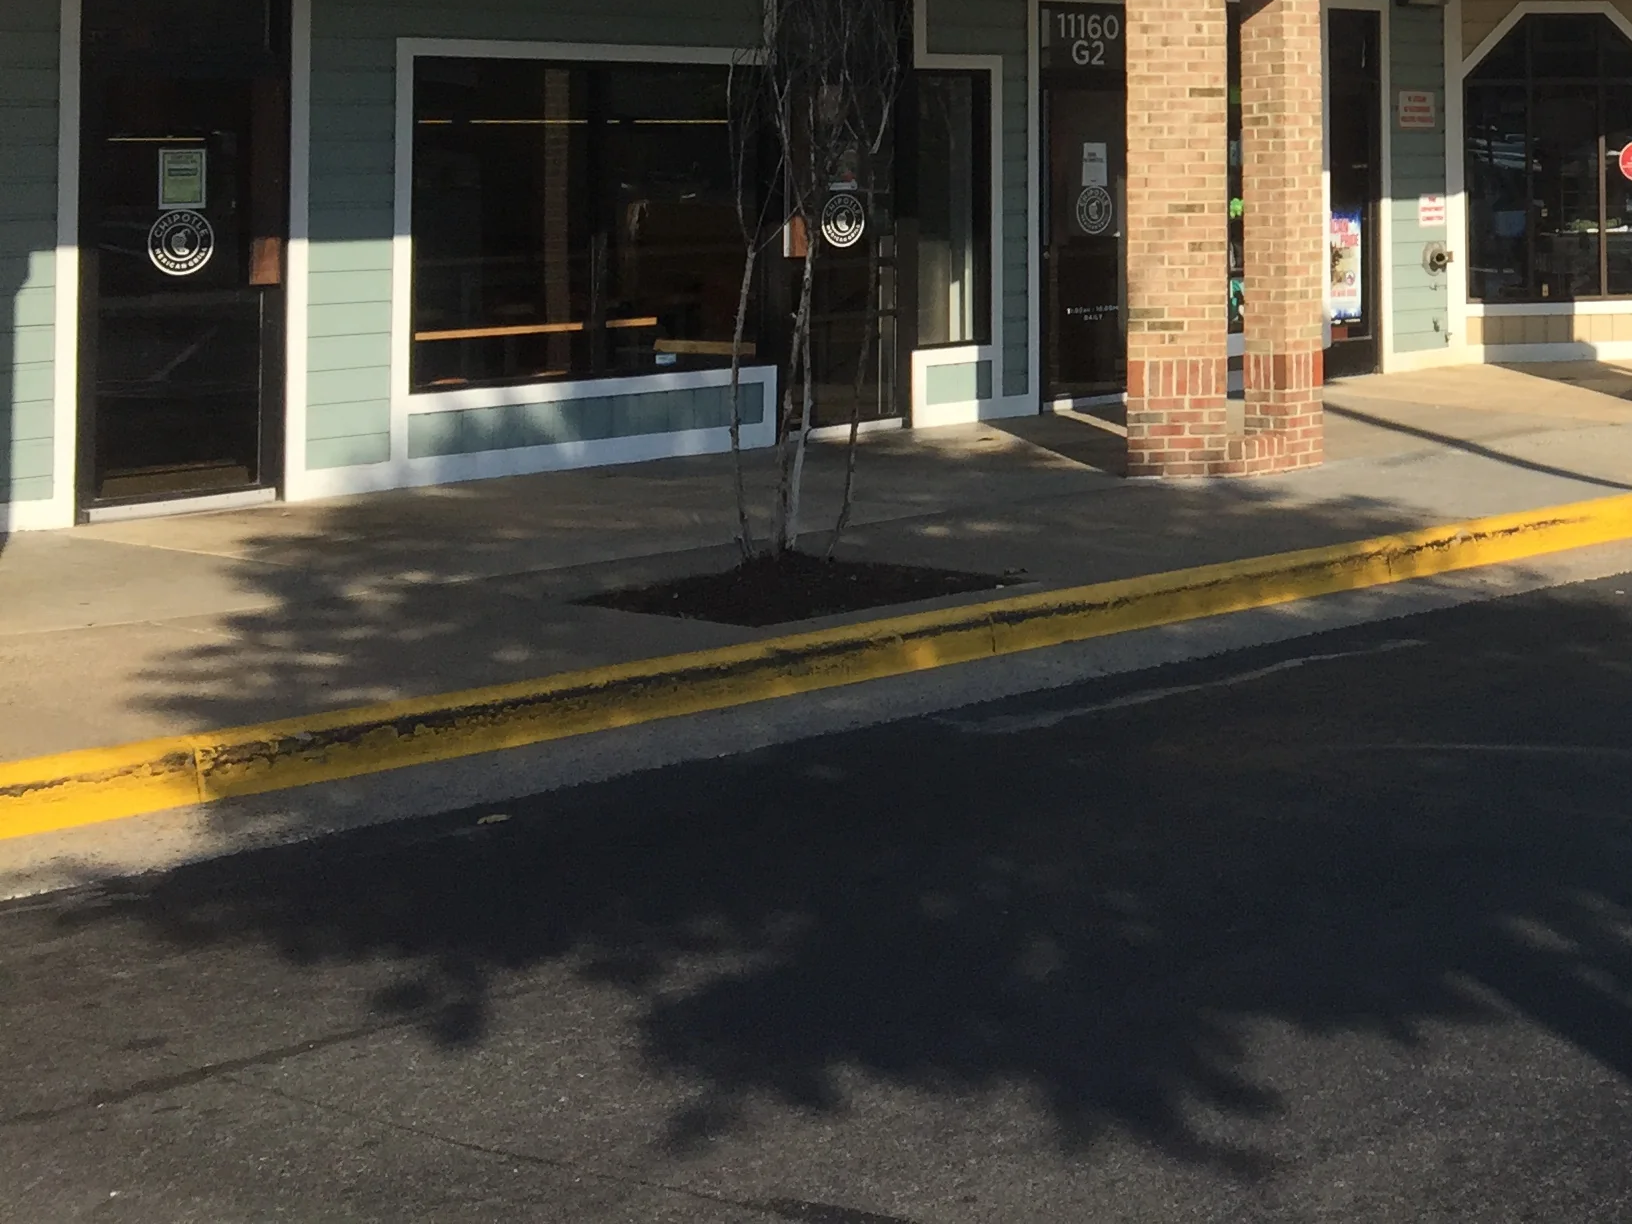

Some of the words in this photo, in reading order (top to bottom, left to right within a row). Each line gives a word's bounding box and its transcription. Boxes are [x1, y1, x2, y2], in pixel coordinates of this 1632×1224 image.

[1056, 12, 1119, 40] 11160
[1071, 39, 1105, 65] G2
[825, 198, 861, 217] CHIPOTLE
[154, 213, 209, 238] CHIPOTLE
